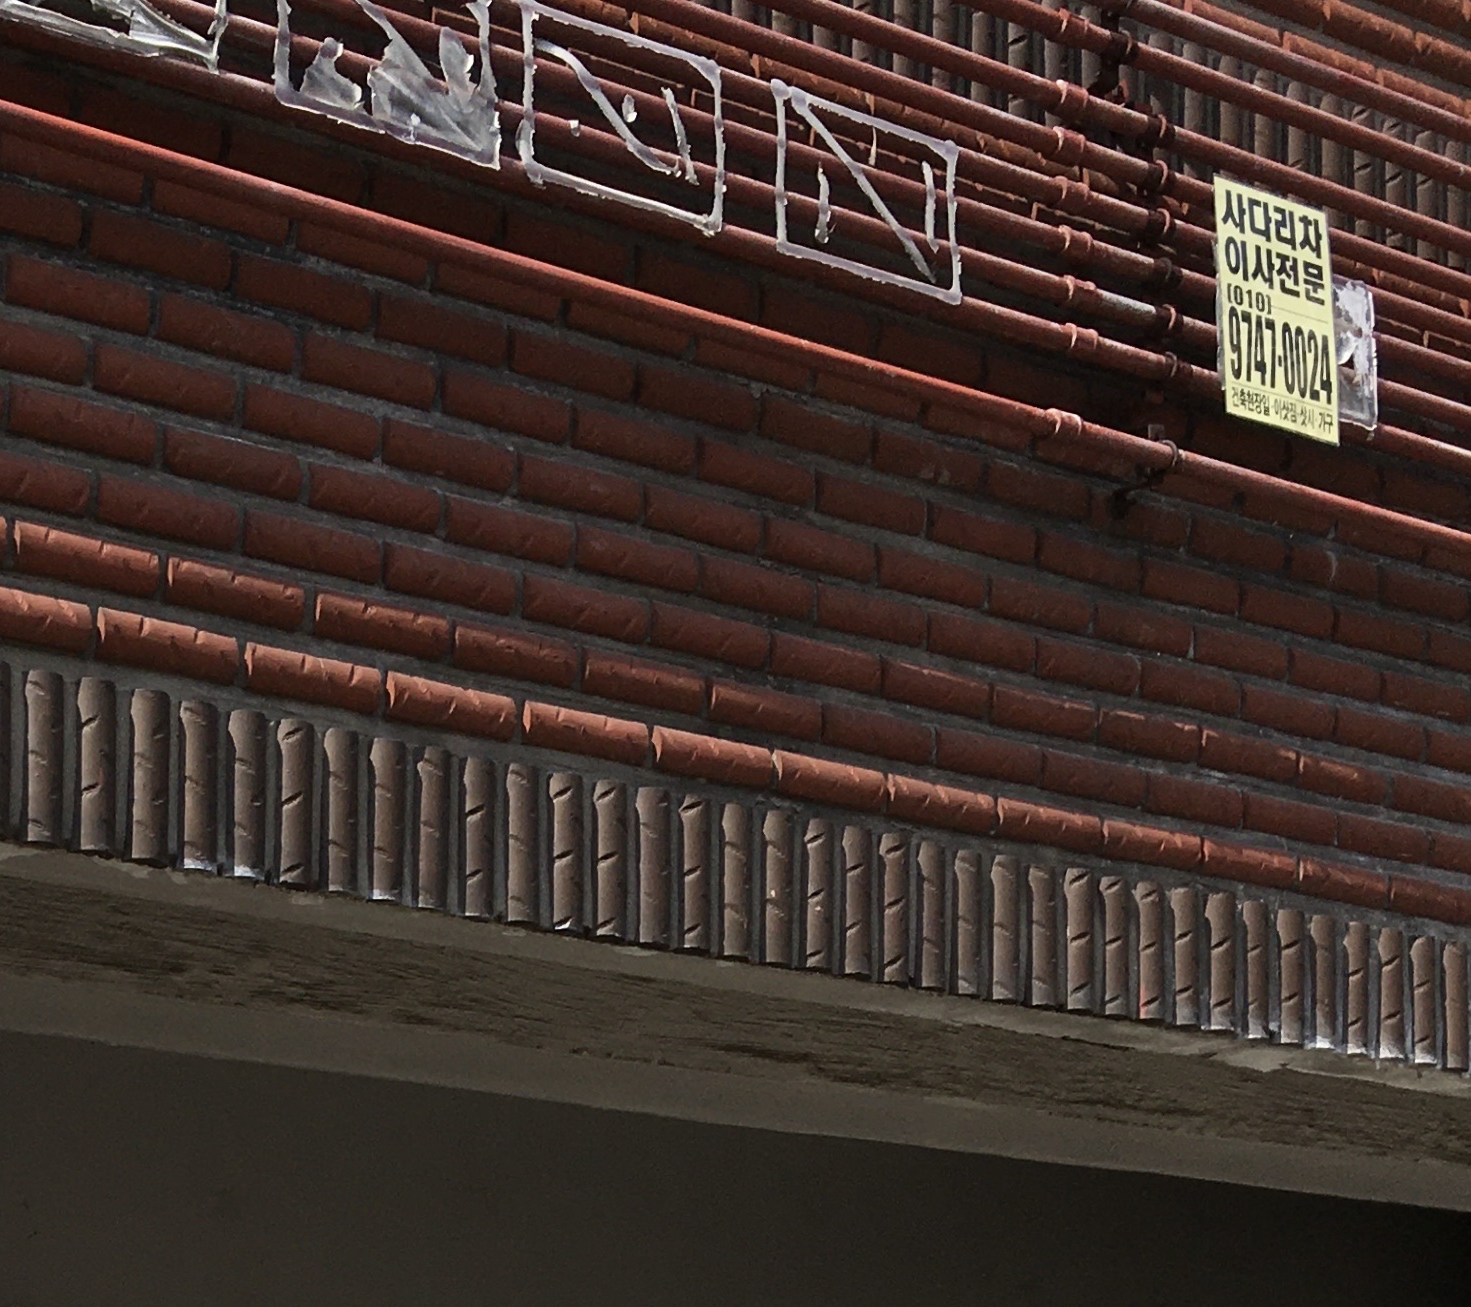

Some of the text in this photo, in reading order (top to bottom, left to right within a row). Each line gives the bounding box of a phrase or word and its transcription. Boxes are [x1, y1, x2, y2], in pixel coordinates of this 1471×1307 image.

[1221, 189, 1322, 259] 사다리차
[1224, 236, 1325, 306] 이사전문
[1229, 306, 1332, 405] 9747-0024
